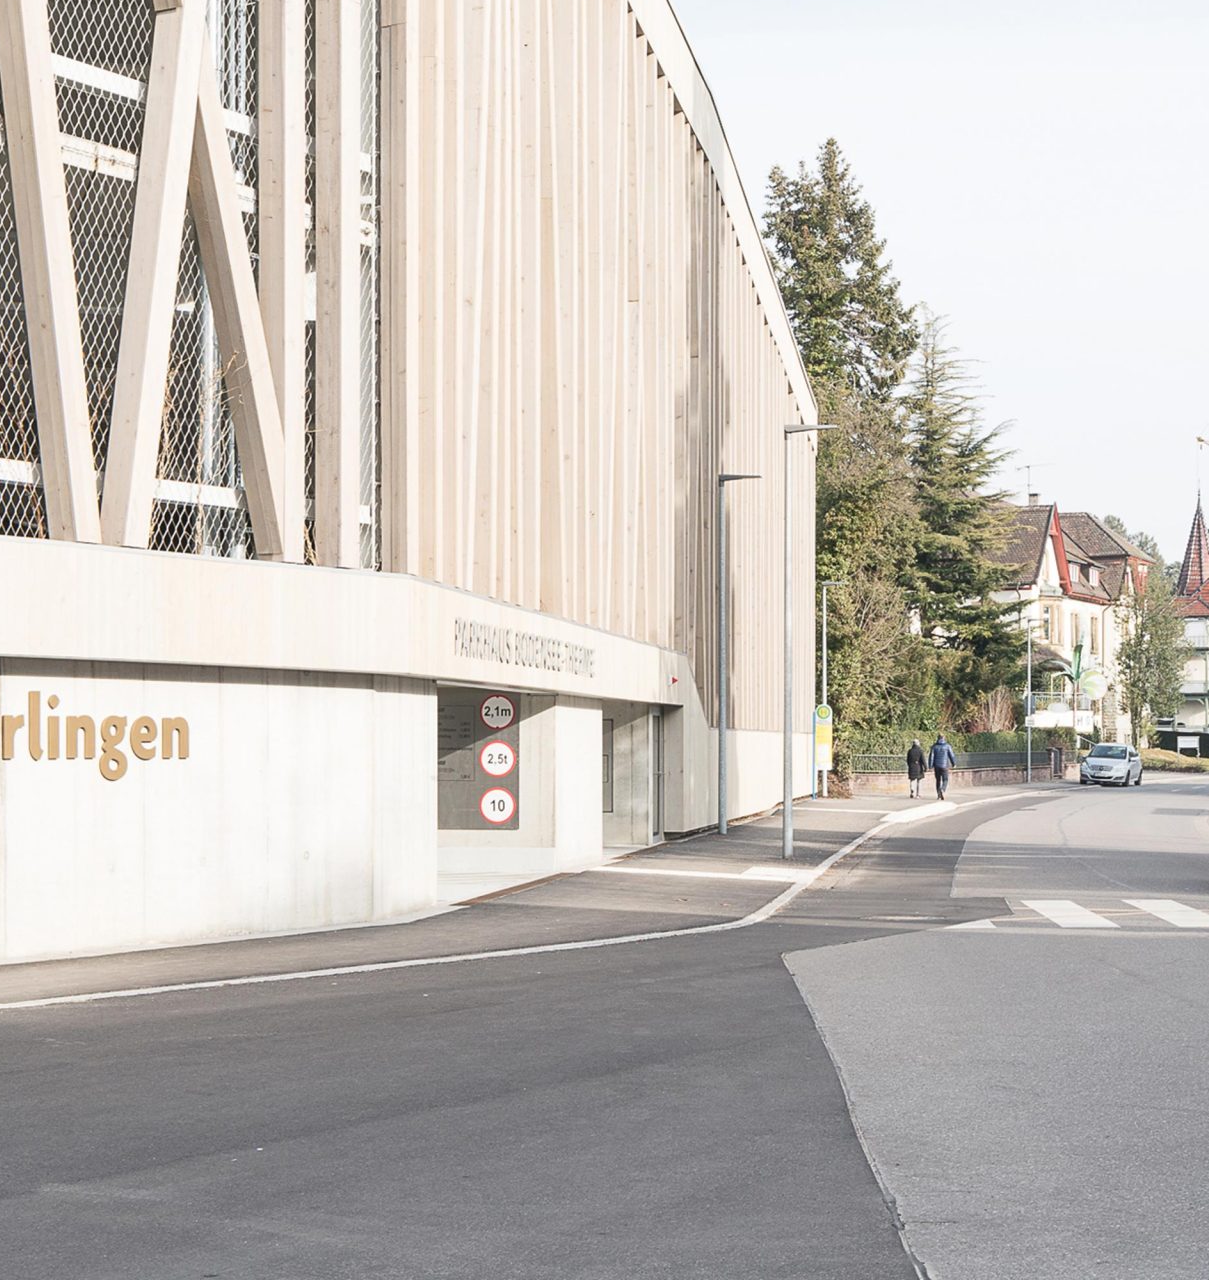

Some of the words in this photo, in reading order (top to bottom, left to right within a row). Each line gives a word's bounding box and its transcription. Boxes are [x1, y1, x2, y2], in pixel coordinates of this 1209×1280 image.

[454, 617, 513, 665] PARKHAUS
[484, 706, 511, 718] 2,1m
[490, 799, 506, 812] 10
